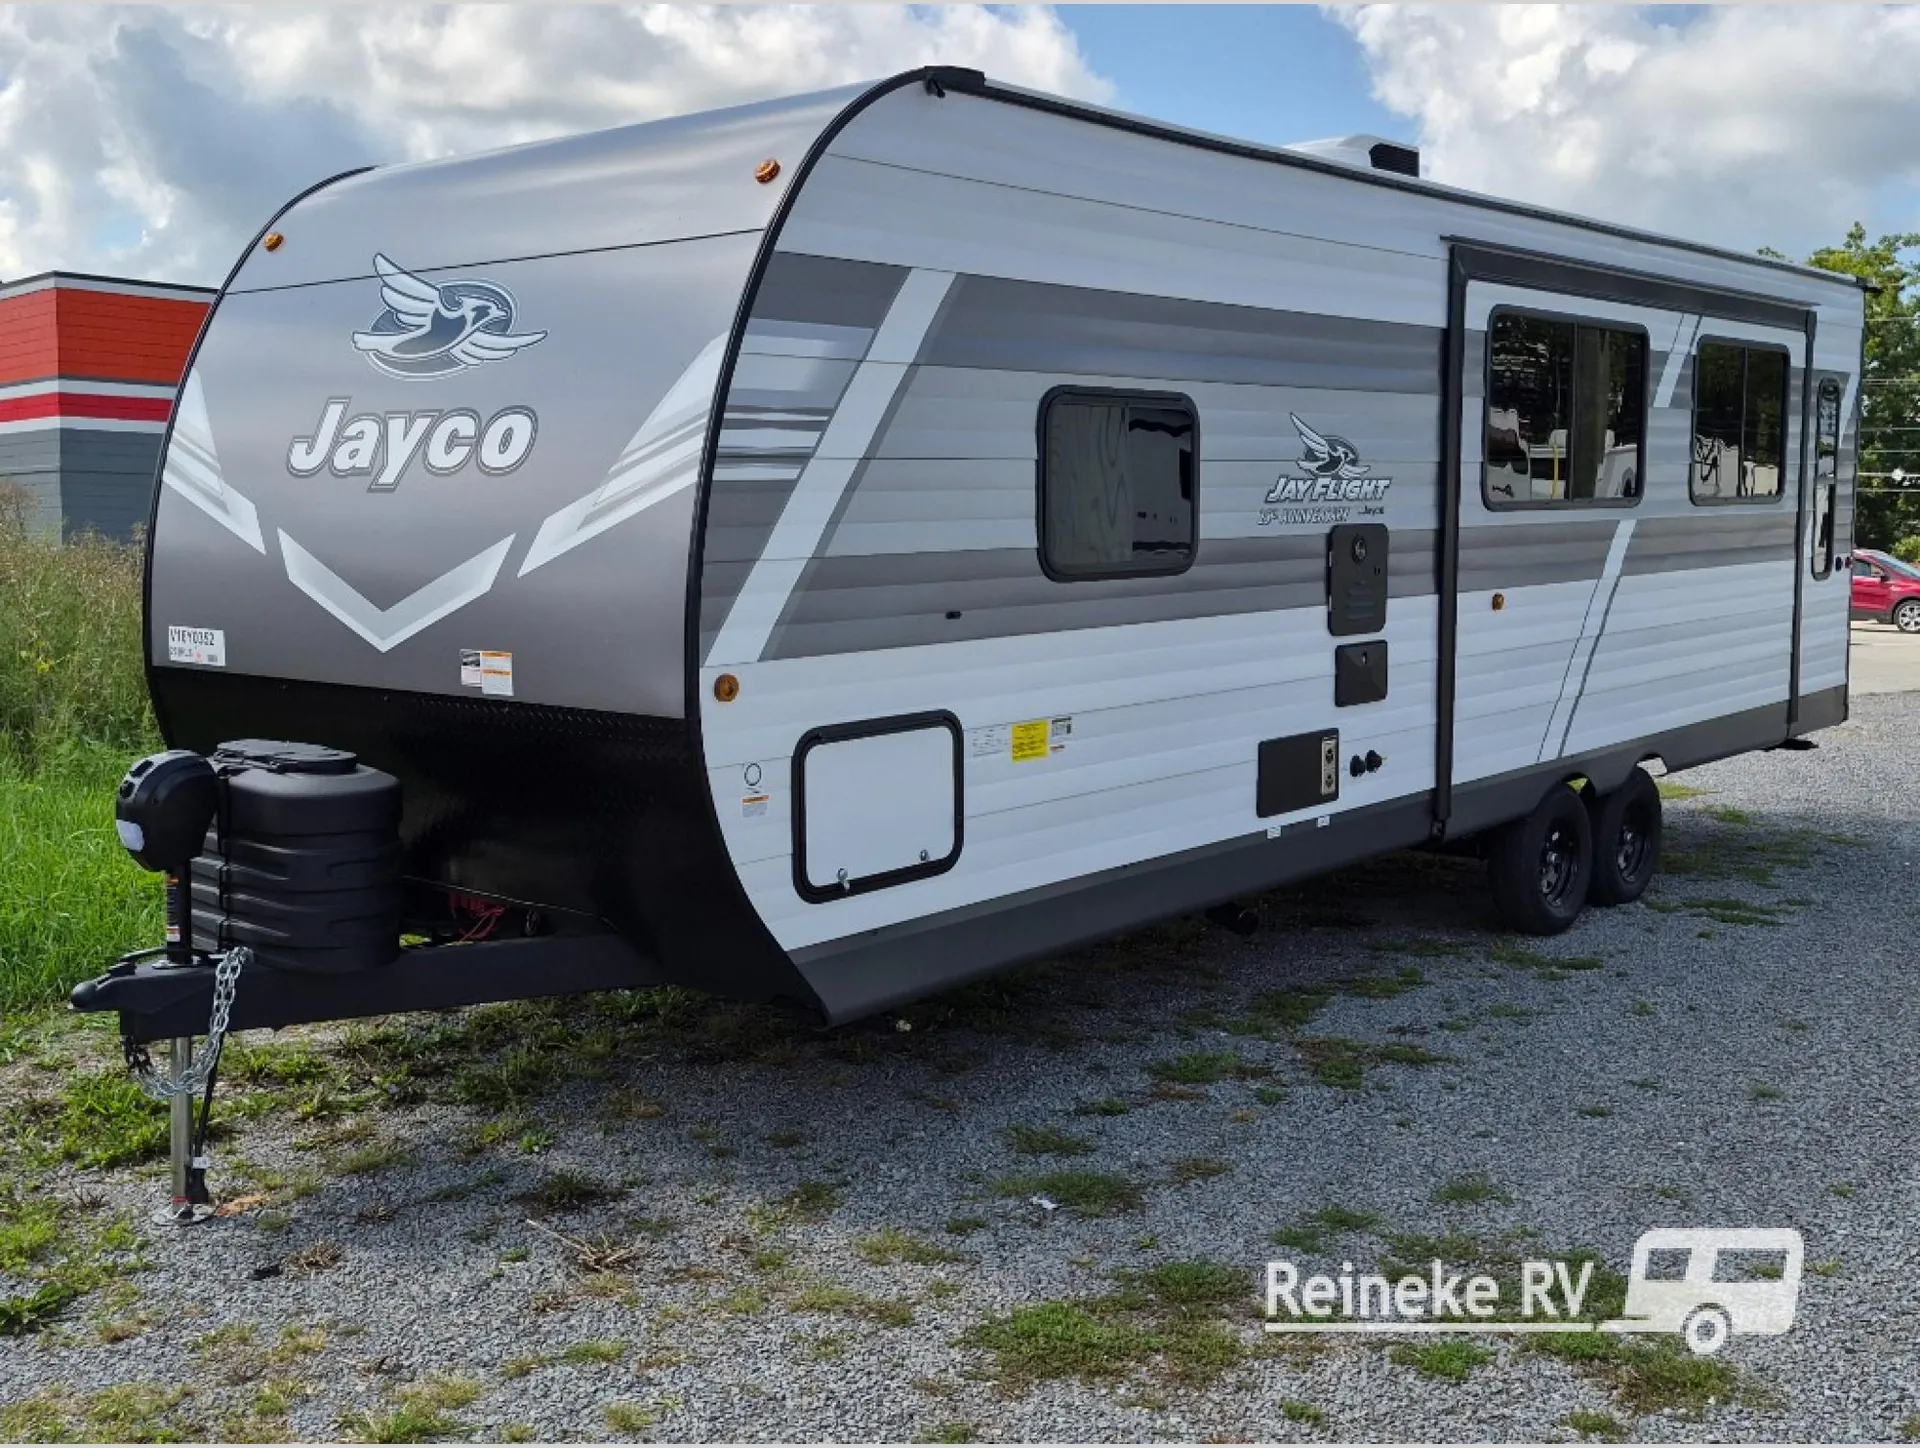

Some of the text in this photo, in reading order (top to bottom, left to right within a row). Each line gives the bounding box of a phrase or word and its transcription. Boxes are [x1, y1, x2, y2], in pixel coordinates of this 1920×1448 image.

[286, 396, 539, 493] Jayco
[1264, 474, 1393, 503] JAY FLIGHT
